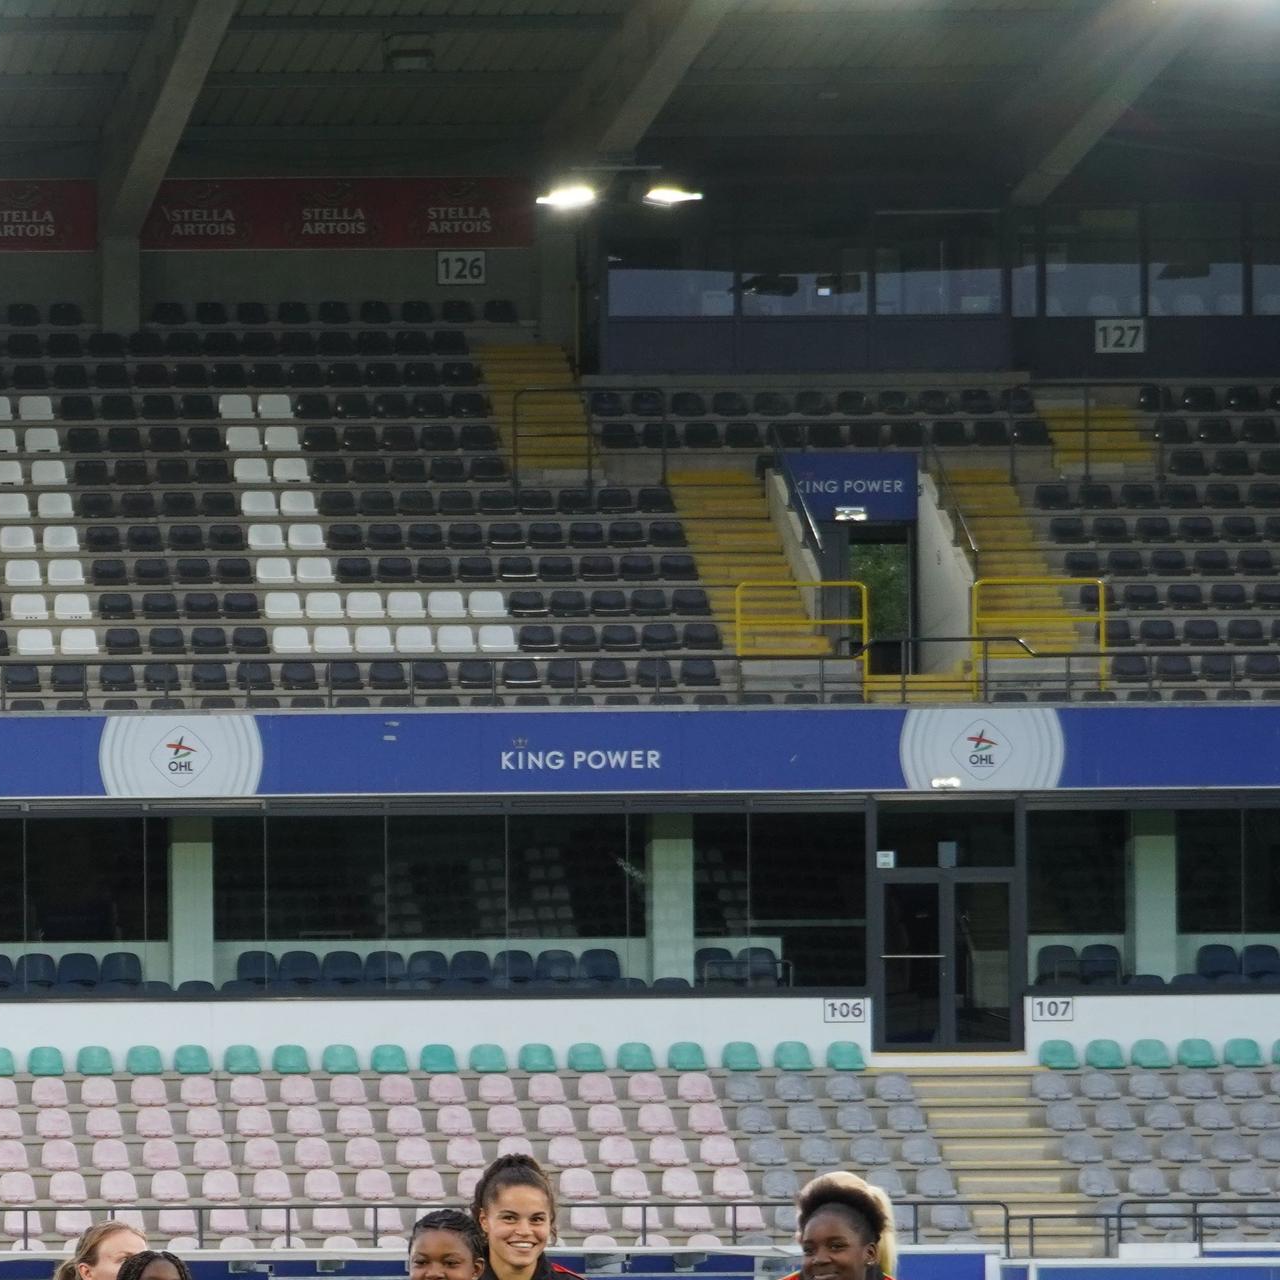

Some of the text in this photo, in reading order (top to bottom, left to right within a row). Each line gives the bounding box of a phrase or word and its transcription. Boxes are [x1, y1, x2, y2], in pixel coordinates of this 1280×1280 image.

[170, 209, 235, 222] STELLA
[302, 207, 365, 221] STELLA
[427, 207, 490, 220] STELLA
[170, 222, 235, 236] ARTOIS
[301, 221, 366, 234] ARTOIS
[426, 220, 492, 234] ARTOIS
[440, 257, 482, 279] 126
[1098, 325, 1141, 348] 127
[797, 480, 904, 493] KING POWER
[168, 760, 193, 772] OHL
[500, 750, 662, 769] KING POWER
[969, 753, 994, 765] OHL
[827, 1001, 863, 1018] 106
[1035, 1000, 1070, 1017] 107
